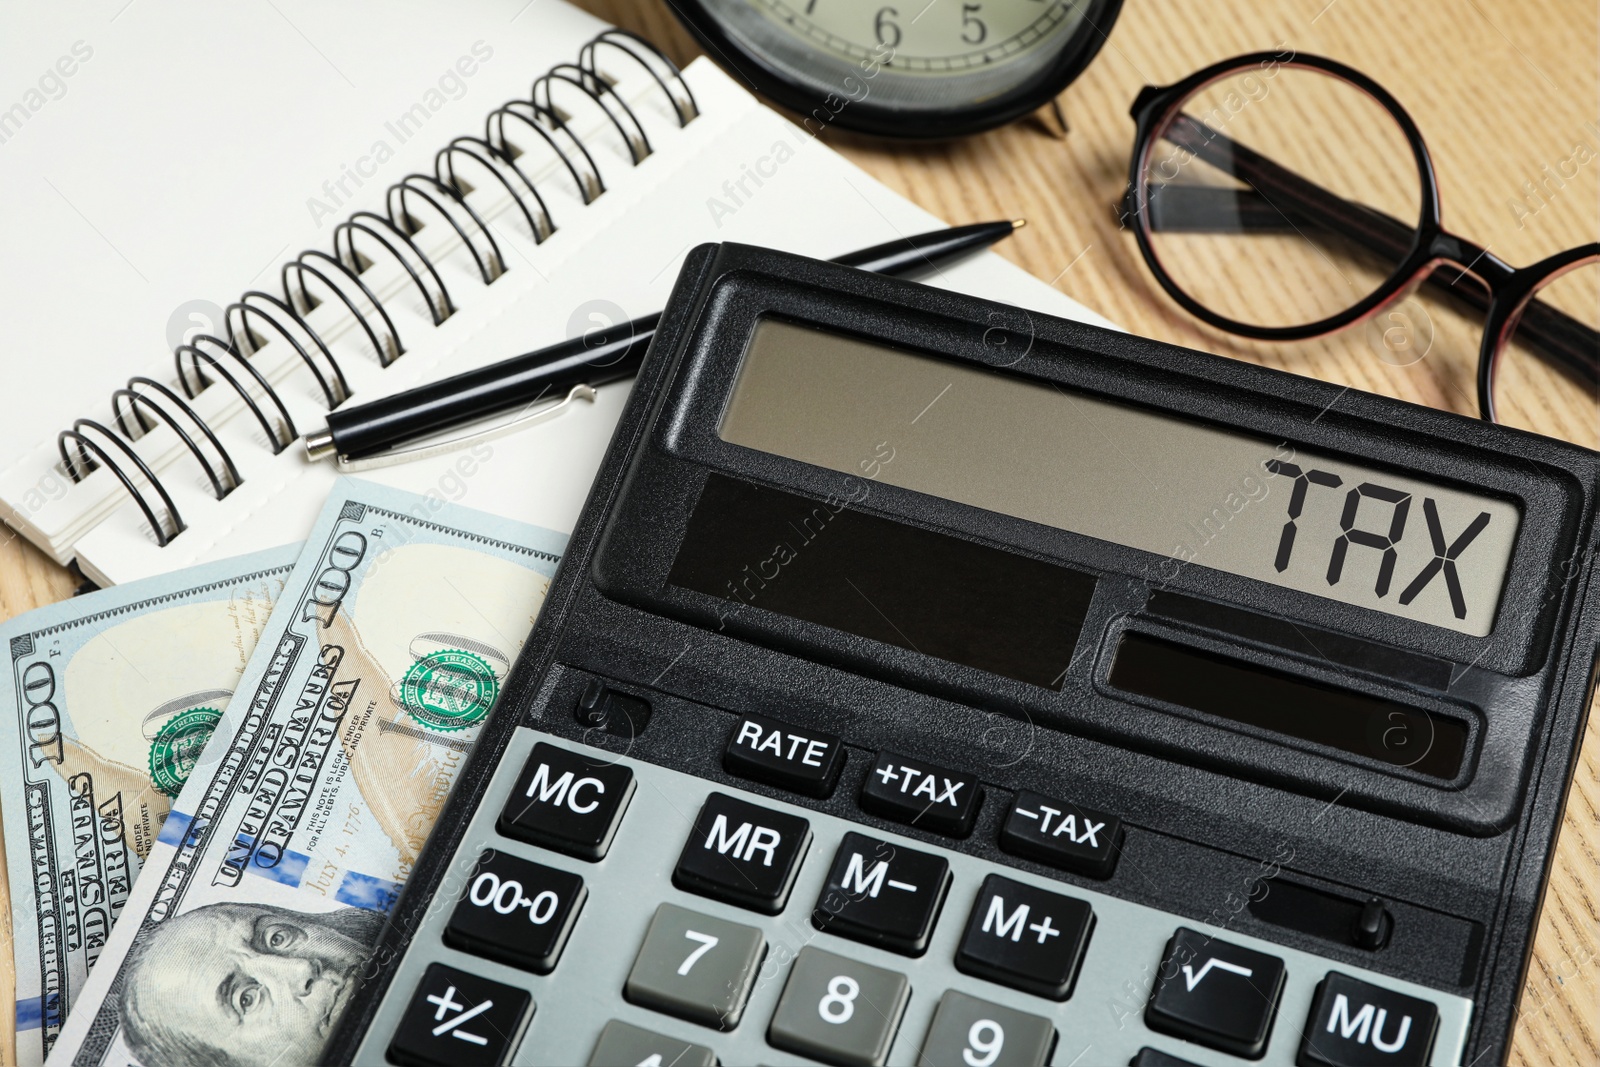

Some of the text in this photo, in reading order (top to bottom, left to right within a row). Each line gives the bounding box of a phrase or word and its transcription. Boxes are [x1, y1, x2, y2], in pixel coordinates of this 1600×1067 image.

[874, 6, 903, 49] 6
[960, 3, 987, 46] 5
[1264, 458, 1491, 620] TAX
[301, 530, 367, 630] 100
[22, 660, 65, 770] 100
[736, 720, 829, 768] RATE
[151, 638, 298, 922] ONE HUNDRED DOLLARS
[211, 644, 345, 887] UNITED STATES
[238, 723, 284, 795] THE
[255, 678, 361, 869] OF AMERICA
[306, 714, 361, 833] THIS NOTE IS LEGAL TENDER
[306, 701, 377, 852] FOR ALL DEBTS, PUBLIC AND PRIVATE
[525, 763, 605, 814] MC
[875, 763, 965, 807] +TAX
[67, 771, 106, 908] STATES
[134, 823, 145, 859] TENDER
[141, 802, 151, 837] PRIVATE
[703, 813, 781, 867] MR
[28, 788, 54, 913] DOLLARS
[60, 868, 82, 953] THE
[981, 895, 1060, 944] M+
[676, 929, 719, 976] 7
[817, 975, 860, 1024] 8
[1326, 993, 1413, 1054] MU
[962, 1018, 1005, 1067] 9
